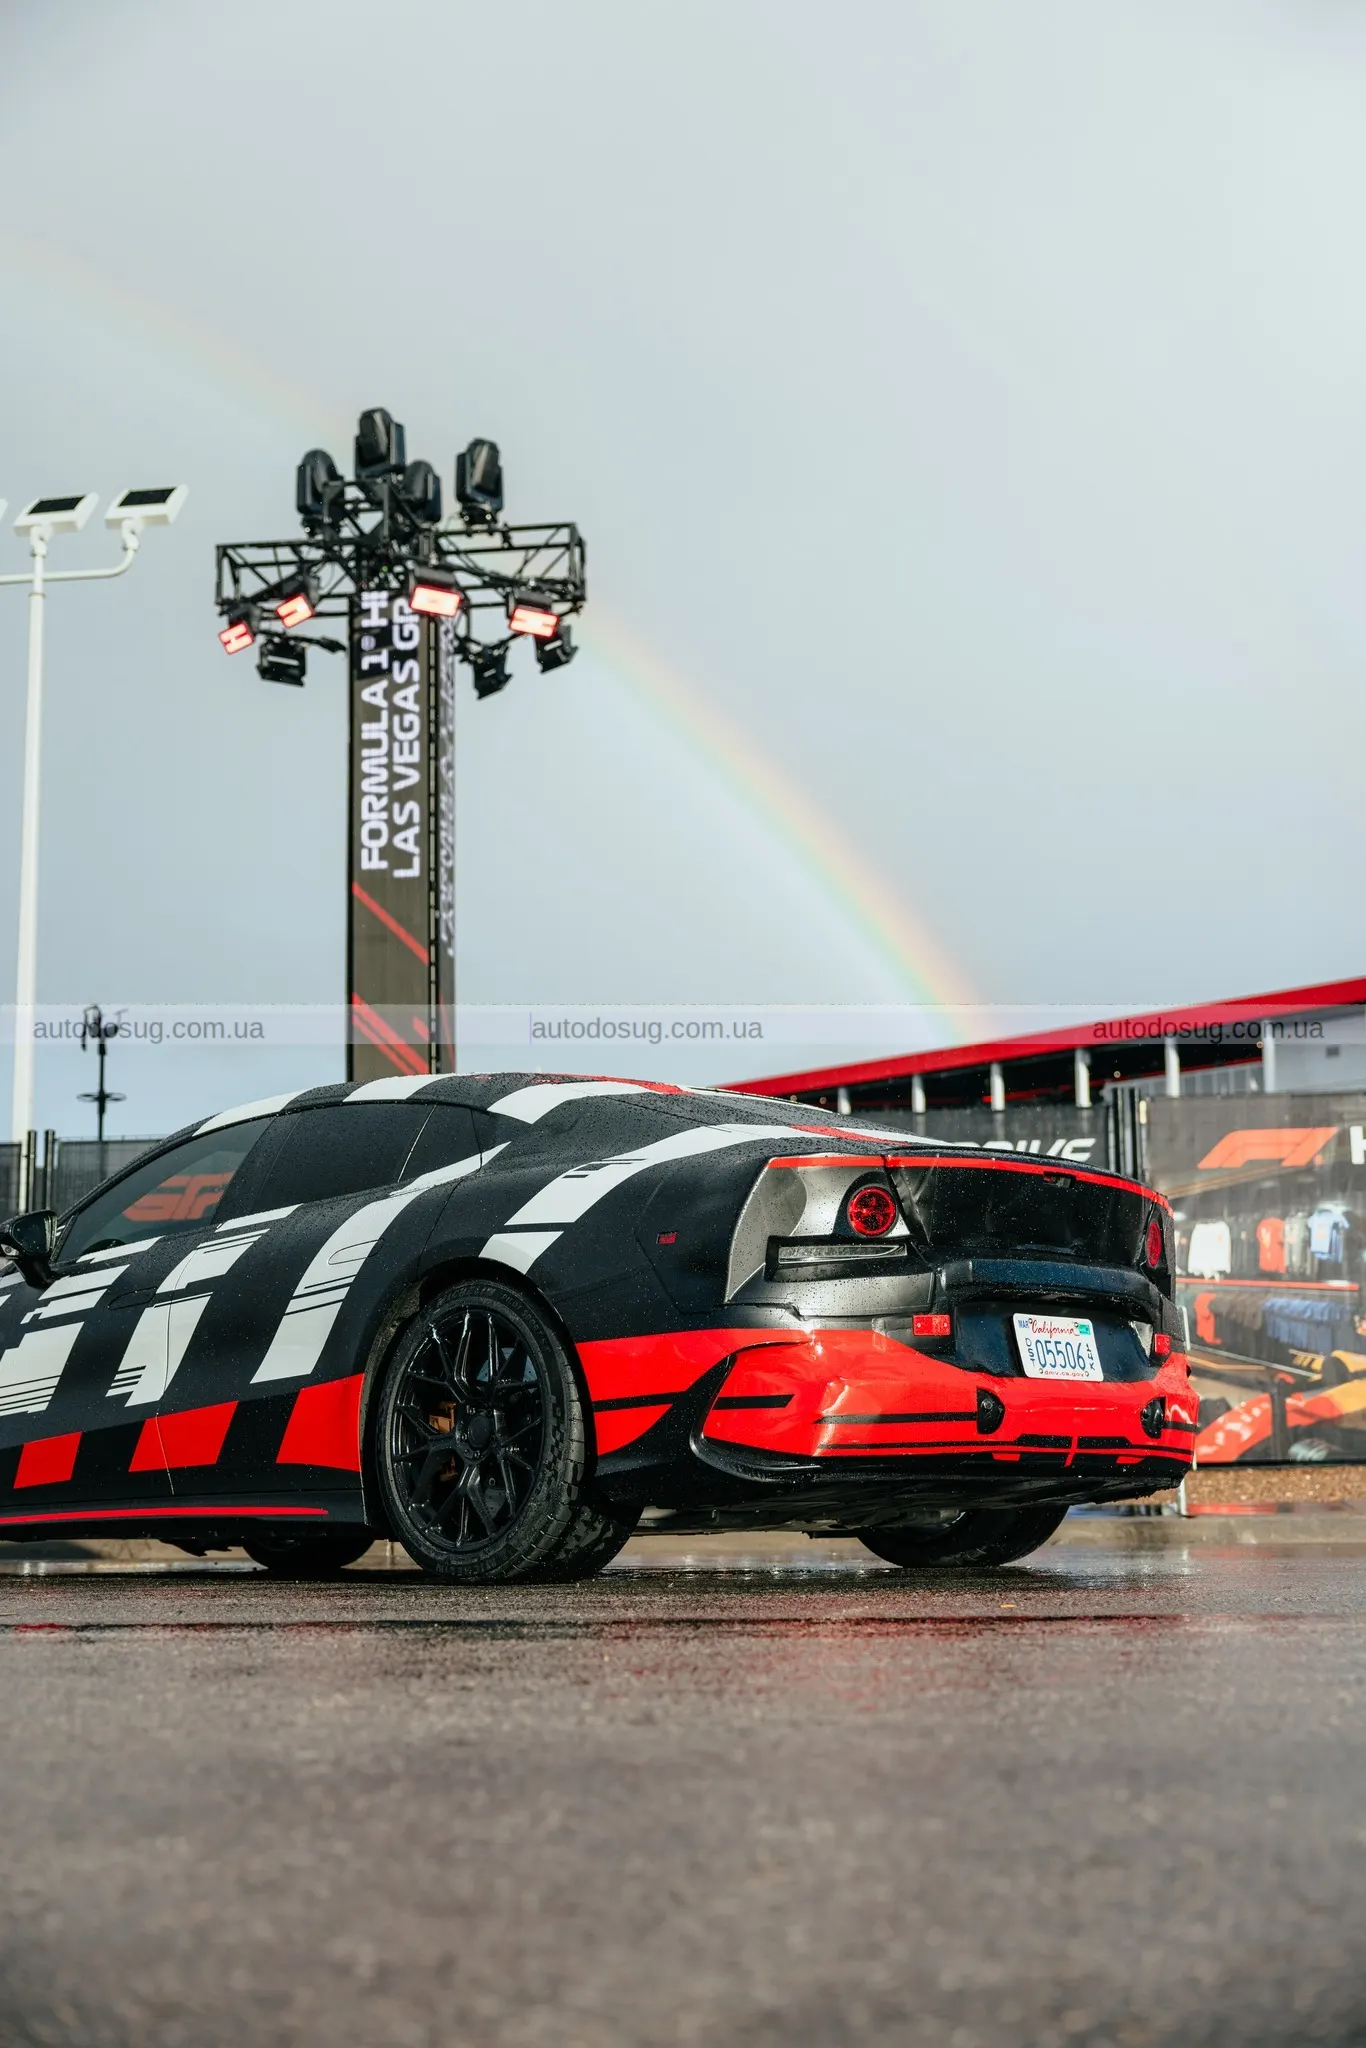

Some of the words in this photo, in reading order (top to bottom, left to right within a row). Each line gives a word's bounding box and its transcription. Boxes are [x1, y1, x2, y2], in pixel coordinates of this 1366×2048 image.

[392, 658, 420, 790] VEGAS
[361, 679, 389, 871] FORMULA
[392, 800, 420, 878] LAS
[1032, 1320, 1080, 1338] California
[1035, 1339, 1086, 1371] 05506
